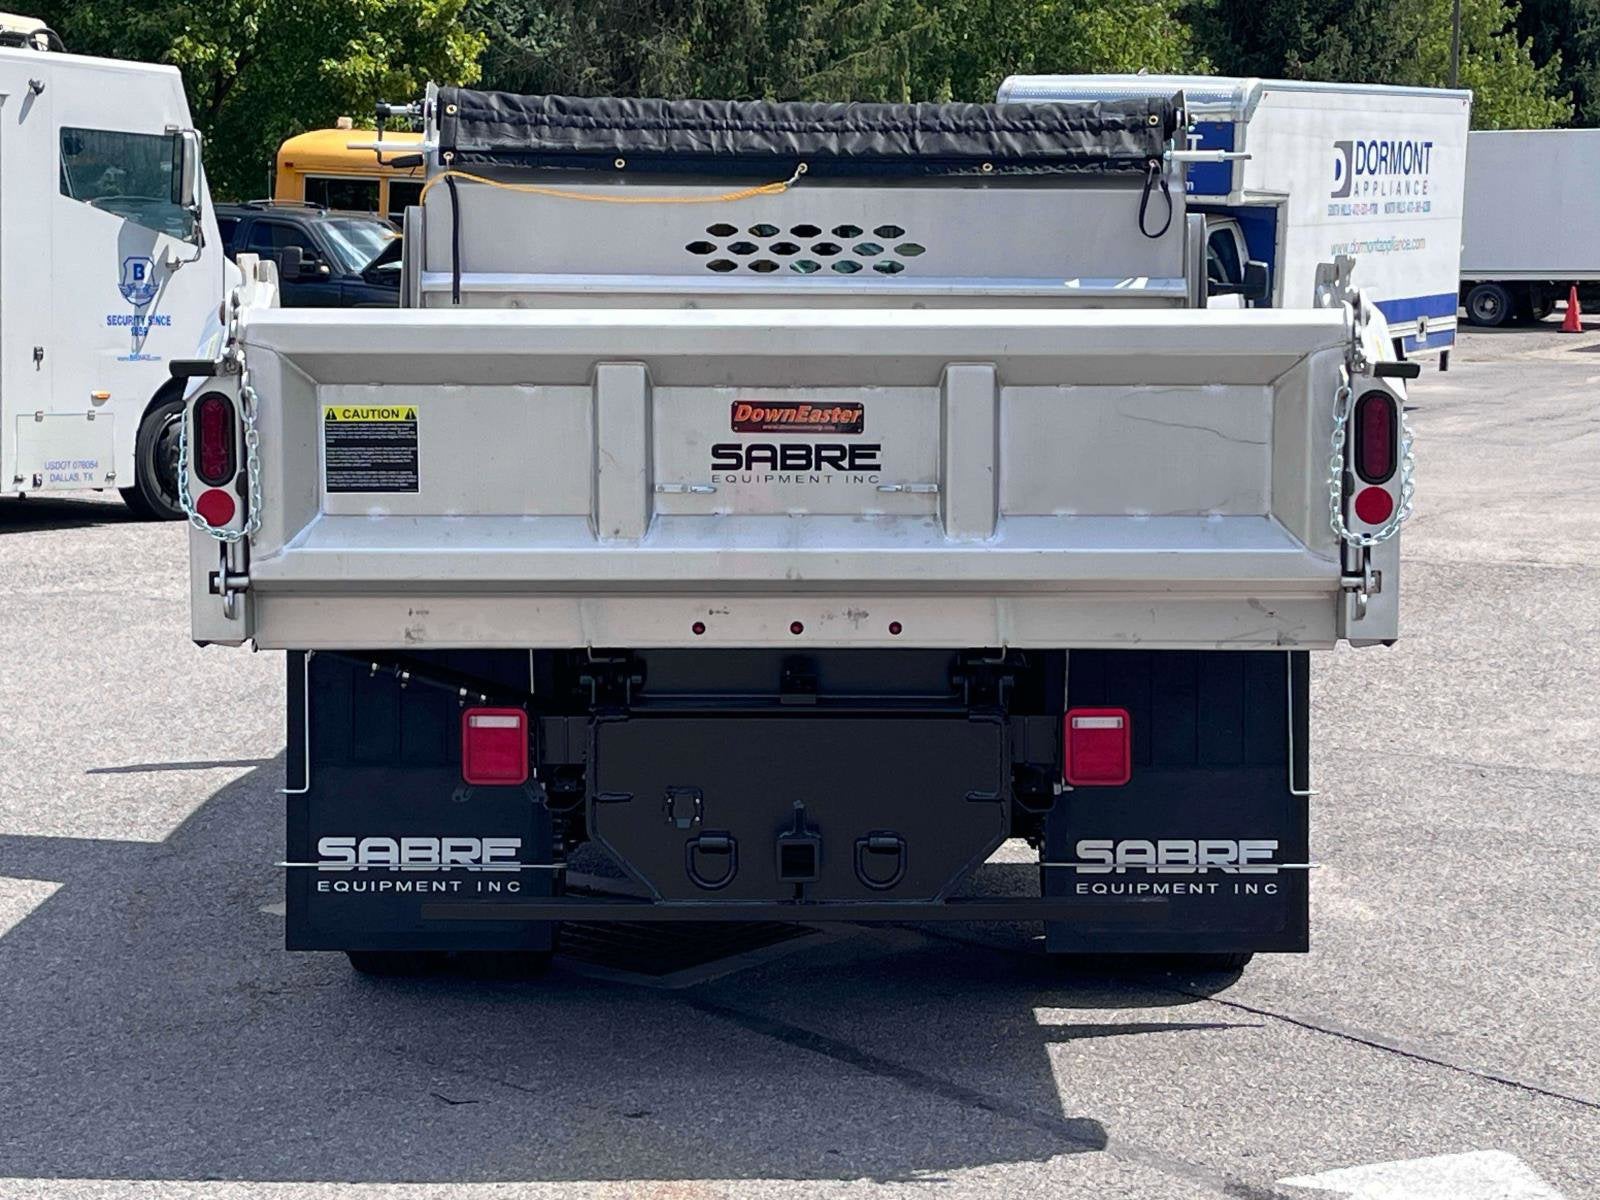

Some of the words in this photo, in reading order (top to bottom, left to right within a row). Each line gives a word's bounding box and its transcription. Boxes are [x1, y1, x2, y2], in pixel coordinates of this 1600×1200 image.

[1355, 140, 1433, 176] DORMONT
[1353, 180, 1429, 198] APPLIANCE
[133, 263, 145, 280] B
[106, 315, 145, 326] SECURITY
[148, 315, 171, 326] SINCE
[342, 408, 400, 420] CAUTION
[734, 404, 862, 424] DownEaster
[711, 443, 882, 471] SABRE
[44, 461, 70, 471] USDOT
[83, 472, 94, 481] TX
[711, 474, 833, 484] EQUIPMENT
[845, 474, 880, 484] INC
[317, 836, 522, 872] SABRE
[1075, 839, 1279, 874] SABRE
[317, 880, 463, 893] EQUIPMENT
[477, 880, 521, 893] INC
[1076, 883, 1220, 895] EQUIPMENT
[1234, 883, 1279, 895] INC
